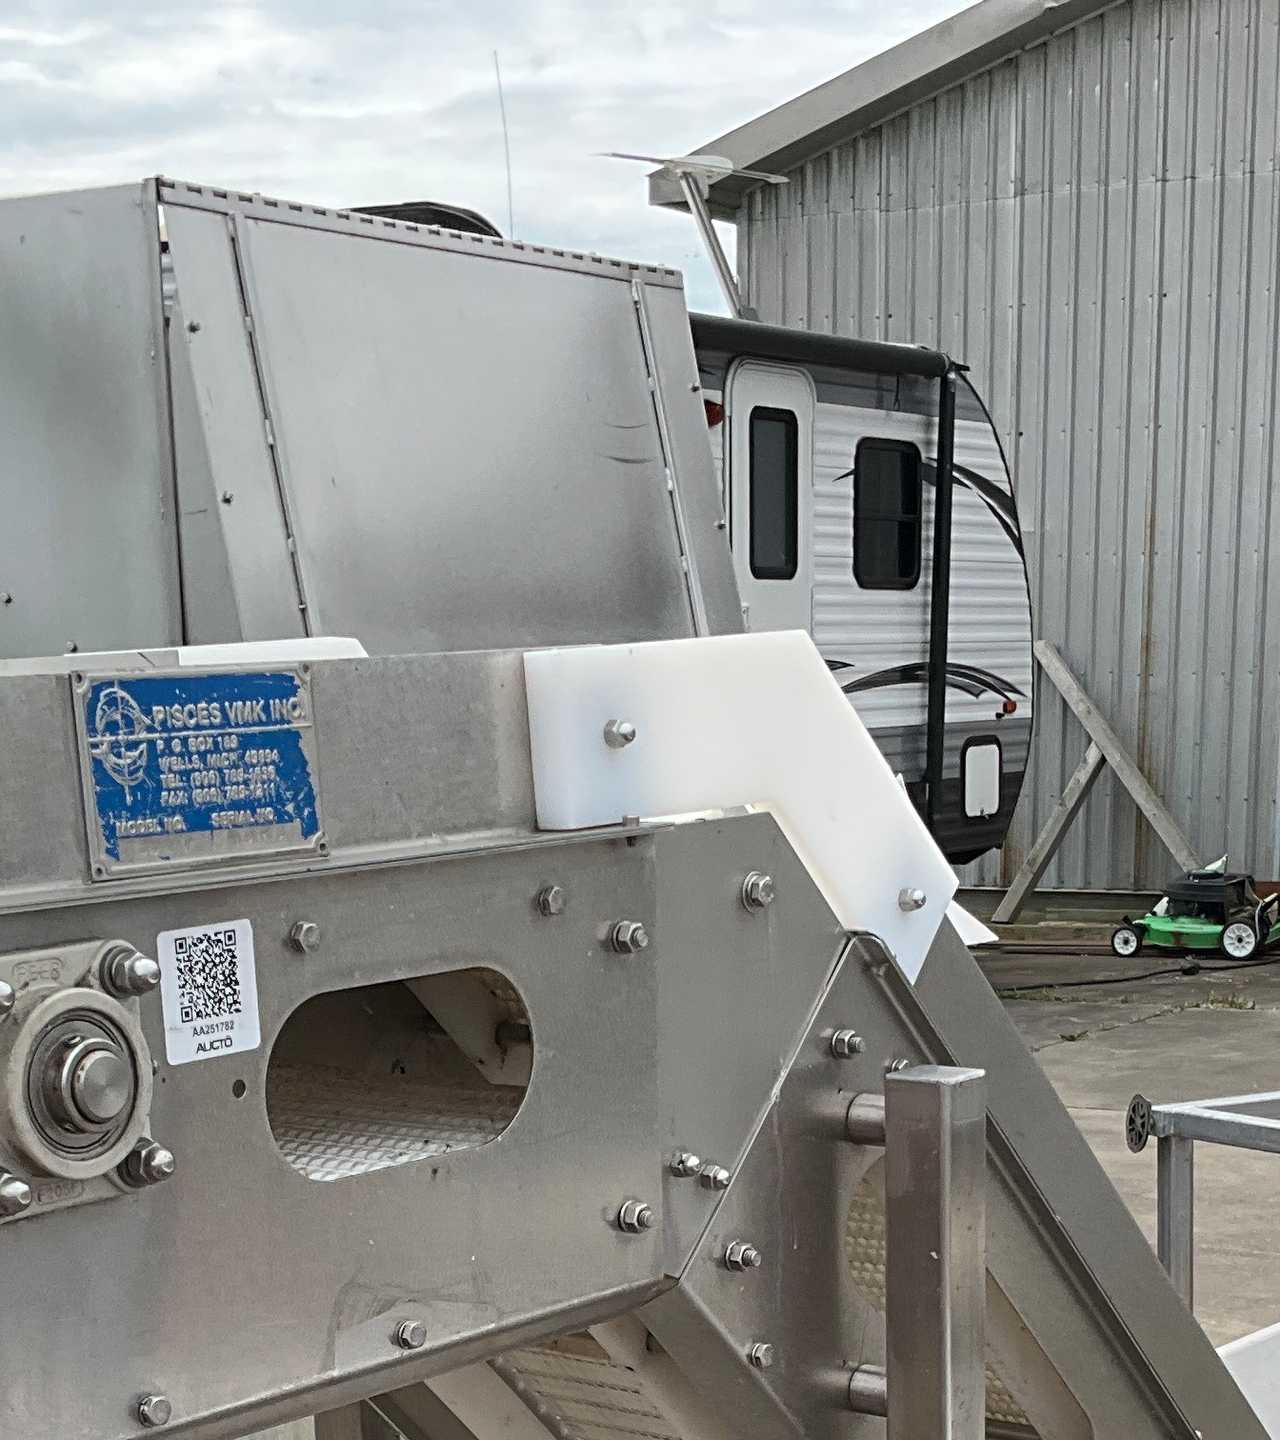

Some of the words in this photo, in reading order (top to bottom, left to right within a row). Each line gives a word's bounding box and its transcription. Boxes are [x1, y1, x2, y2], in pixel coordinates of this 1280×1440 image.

[152, 702, 222, 730] PISCES
[224, 698, 266, 726] VMK
[269, 696, 305, 722] INC.
[188, 736, 214, 752] BOX
[192, 1020, 234, 1037] AA251782
